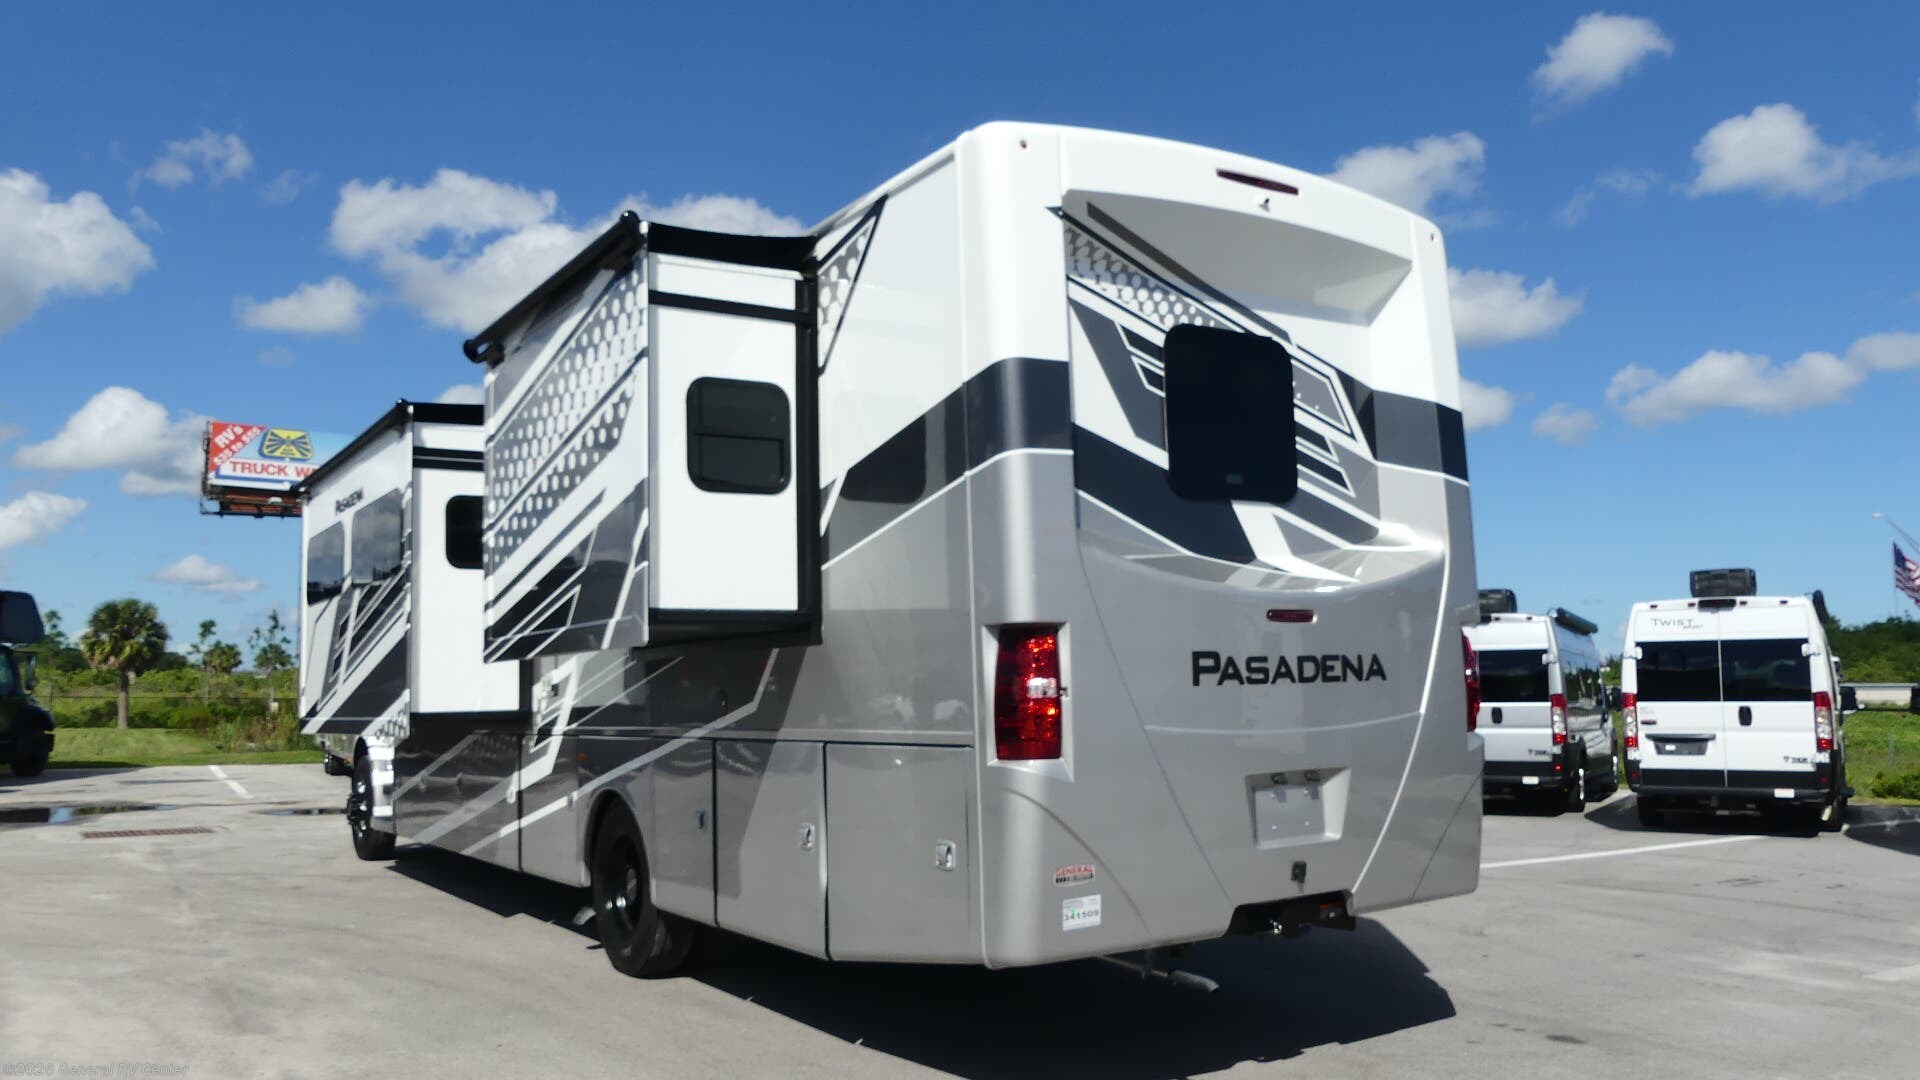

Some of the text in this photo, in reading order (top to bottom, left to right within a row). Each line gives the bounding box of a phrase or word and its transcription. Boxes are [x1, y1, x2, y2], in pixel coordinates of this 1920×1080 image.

[214, 425, 244, 449] RV's
[230, 461, 288, 477] TRUCK
[1192, 651, 1387, 686] PASADENA
